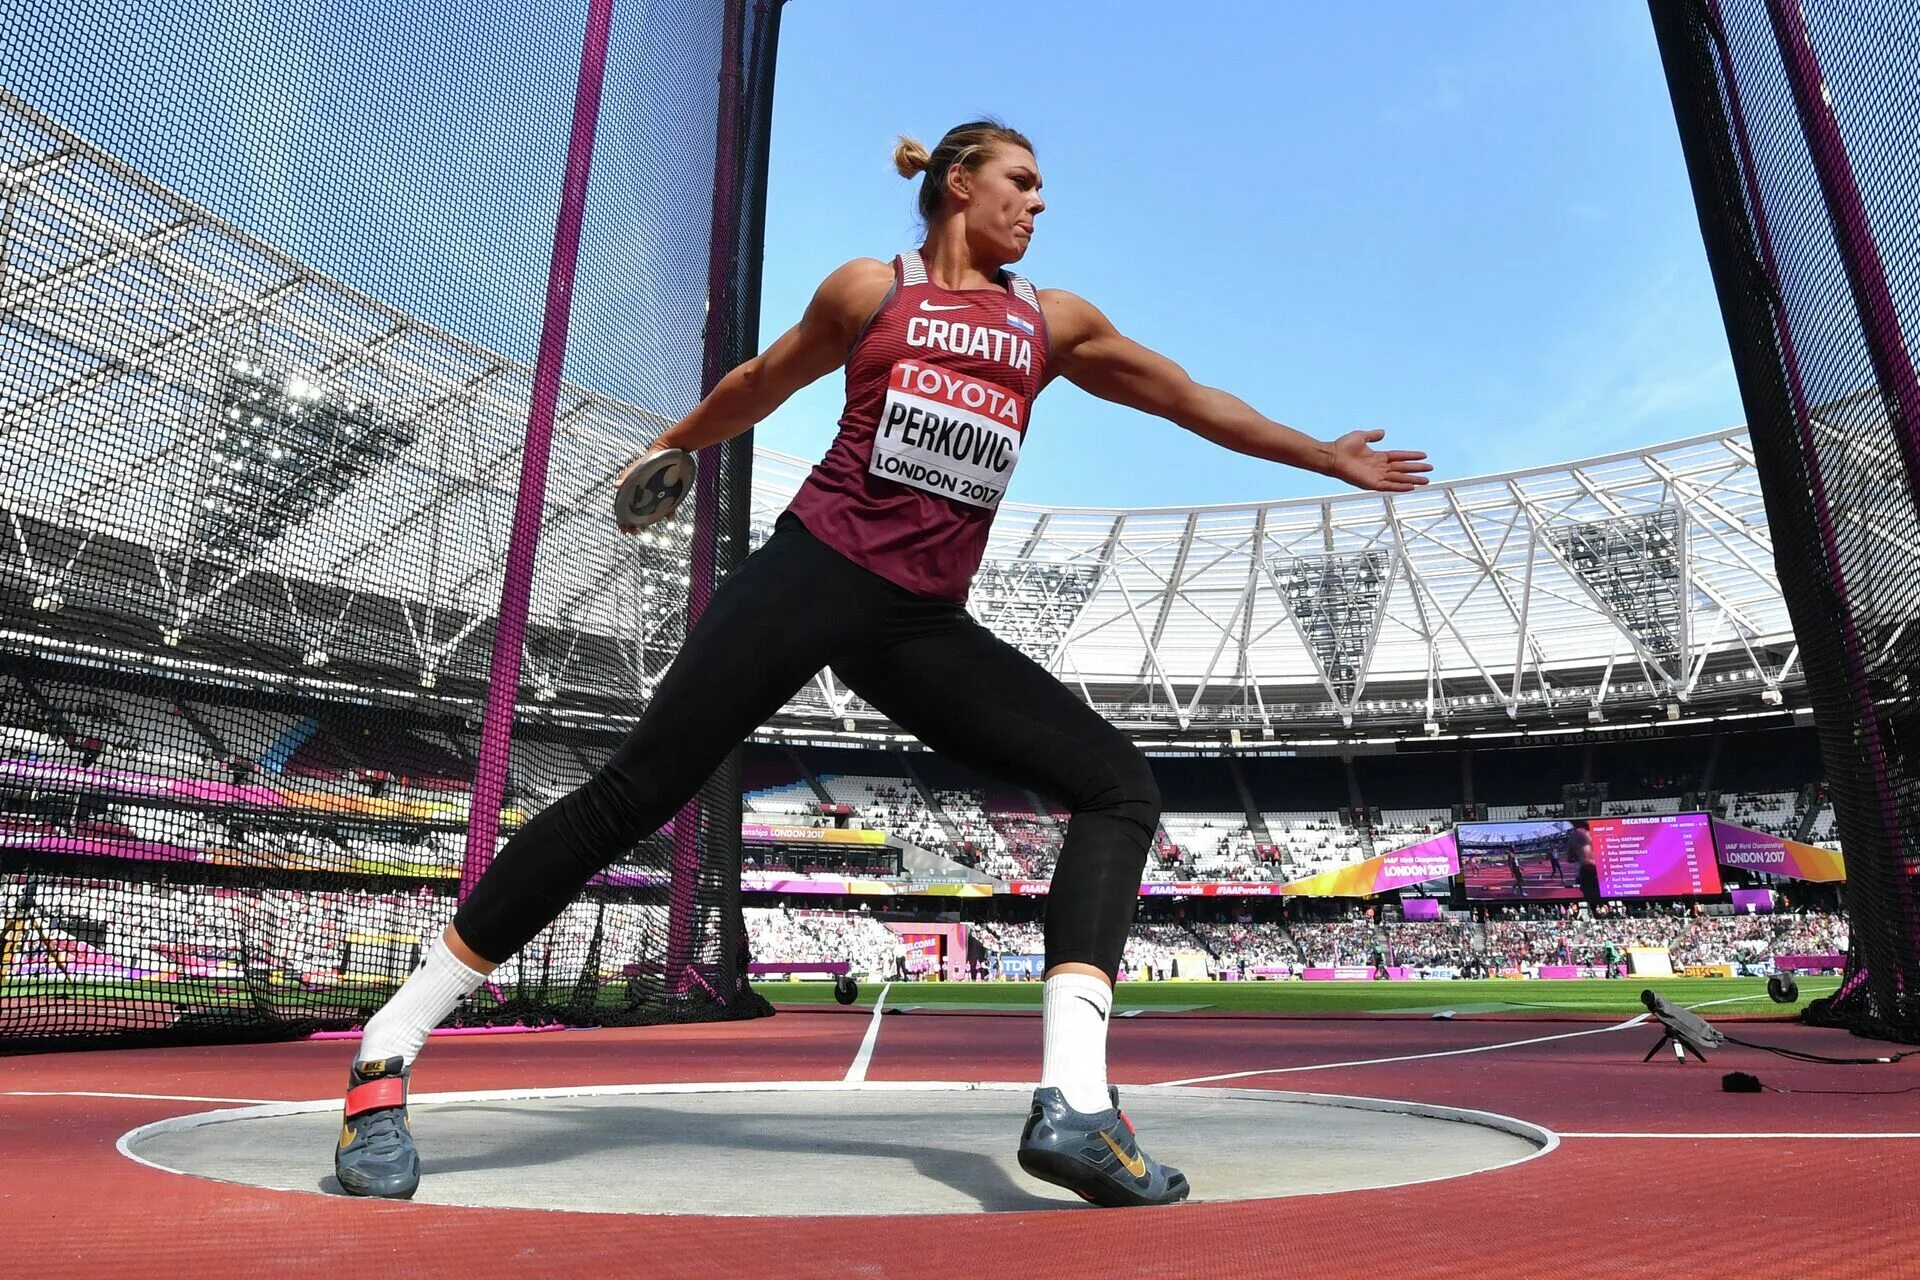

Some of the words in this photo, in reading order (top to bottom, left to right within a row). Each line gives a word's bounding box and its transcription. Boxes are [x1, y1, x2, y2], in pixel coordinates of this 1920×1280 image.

[906, 317, 1032, 376] CROATIA
[898, 363, 1018, 425] TOYOTA
[883, 401, 1014, 474] PERKOVIC
[875, 453, 958, 492] LONDON
[959, 480, 1000, 504] 2017
[1514, 735, 1560, 745] BOBBY
[1563, 731, 1615, 743] MOORE
[1620, 727, 1665, 740] STAND
[1621, 817, 1660, 825] DECATHLON
[742, 828, 769, 838] ionships
[770, 828, 806, 838] LONDON
[806, 830, 825, 838] 2017
[1726, 852, 1765, 863] LONDON
[1764, 851, 1785, 863] 2017
[1384, 865, 1427, 876] LONDON
[1427, 864, 1450, 876] 2017
[903, 937, 936, 951] ELCOME
[363, 1061, 383, 1071] NIKE
